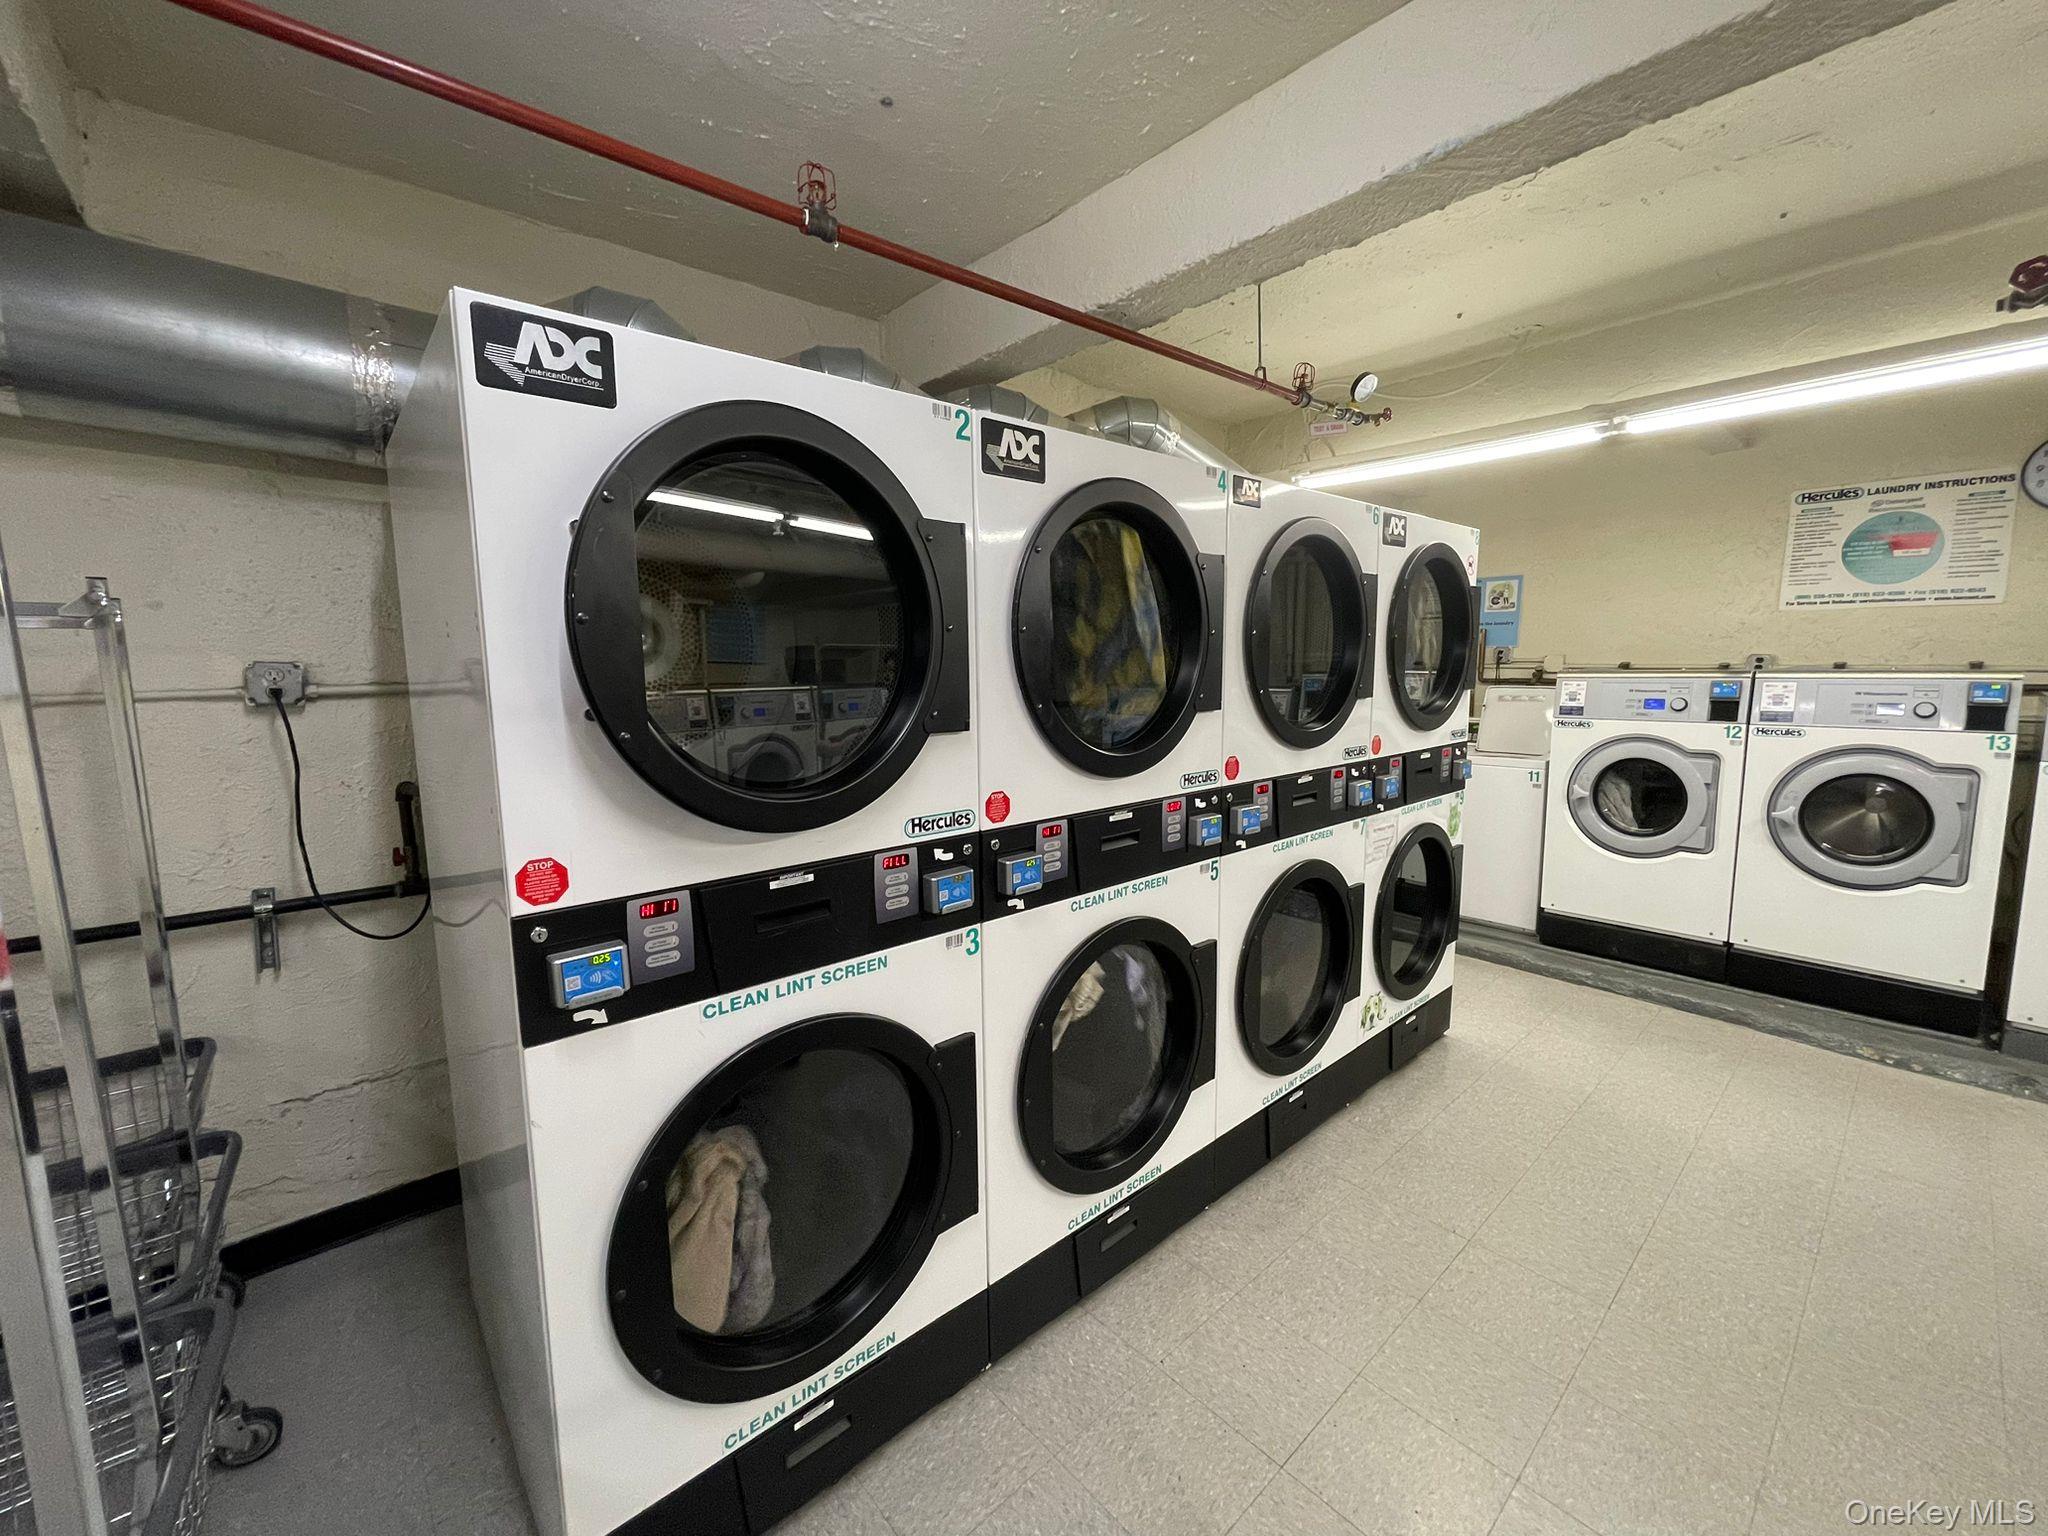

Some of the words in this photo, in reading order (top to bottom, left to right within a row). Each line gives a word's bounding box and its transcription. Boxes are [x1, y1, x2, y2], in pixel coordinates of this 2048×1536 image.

[514, 321, 602, 379] ADC
[955, 409, 971, 441] 2
[999, 428, 1039, 464] ADC
[1217, 470, 1226, 493] 4
[1241, 480, 1259, 498] ADC
[1801, 488, 1859, 503] Hercules
[1867, 483, 1921, 496] LAUNDRY
[1925, 473, 2016, 490] INSTRUCTIONS
[1373, 507, 1380, 525] 6
[1388, 516, 1405, 536] ADC
[1557, 720, 1591, 728] Hercules
[1724, 725, 1742, 739] 12
[1756, 727, 1803, 737] Hercules
[1344, 745, 1367, 757] Hercules
[1985, 735, 2011, 751] 13
[1182, 771, 1218, 786] Hercules
[1528, 771, 1541, 783] 11
[990, 792, 1005, 800] STOP
[911, 812, 971, 834] Hercules
[1360, 818, 1367, 835] 7
[1272, 840, 1295, 853] CLEAN
[1295, 834, 1309, 846] LINT
[1310, 829, 1334, 842] SCREEN
[527, 860, 554, 872] STOP
[884, 855, 906, 869] FILL
[1210, 860, 1219, 881] 5
[1071, 893, 1105, 912] CLEAN
[1108, 886, 1129, 901] LINT
[1131, 876, 1168, 894] SCREEN
[965, 927, 980, 956] 3
[703, 988, 769, 1019] CLEAN
[775, 976, 816, 998] LINT
[821, 956, 888, 985] SCREEN
[1262, 1087, 1284, 1106] CLEAN
[1284, 1077, 1299, 1092] LINT
[1299, 1063, 1322, 1083] SCREEN
[1067, 1203, 1101, 1231] CLEAN
[1103, 1188, 1125, 1208] LINT
[1126, 1164, 1162, 1194] SCREEN
[724, 1401, 786, 1449] CLEAN
[791, 1374, 829, 1407] LINT
[833, 1332, 896, 1379] SCREEN
